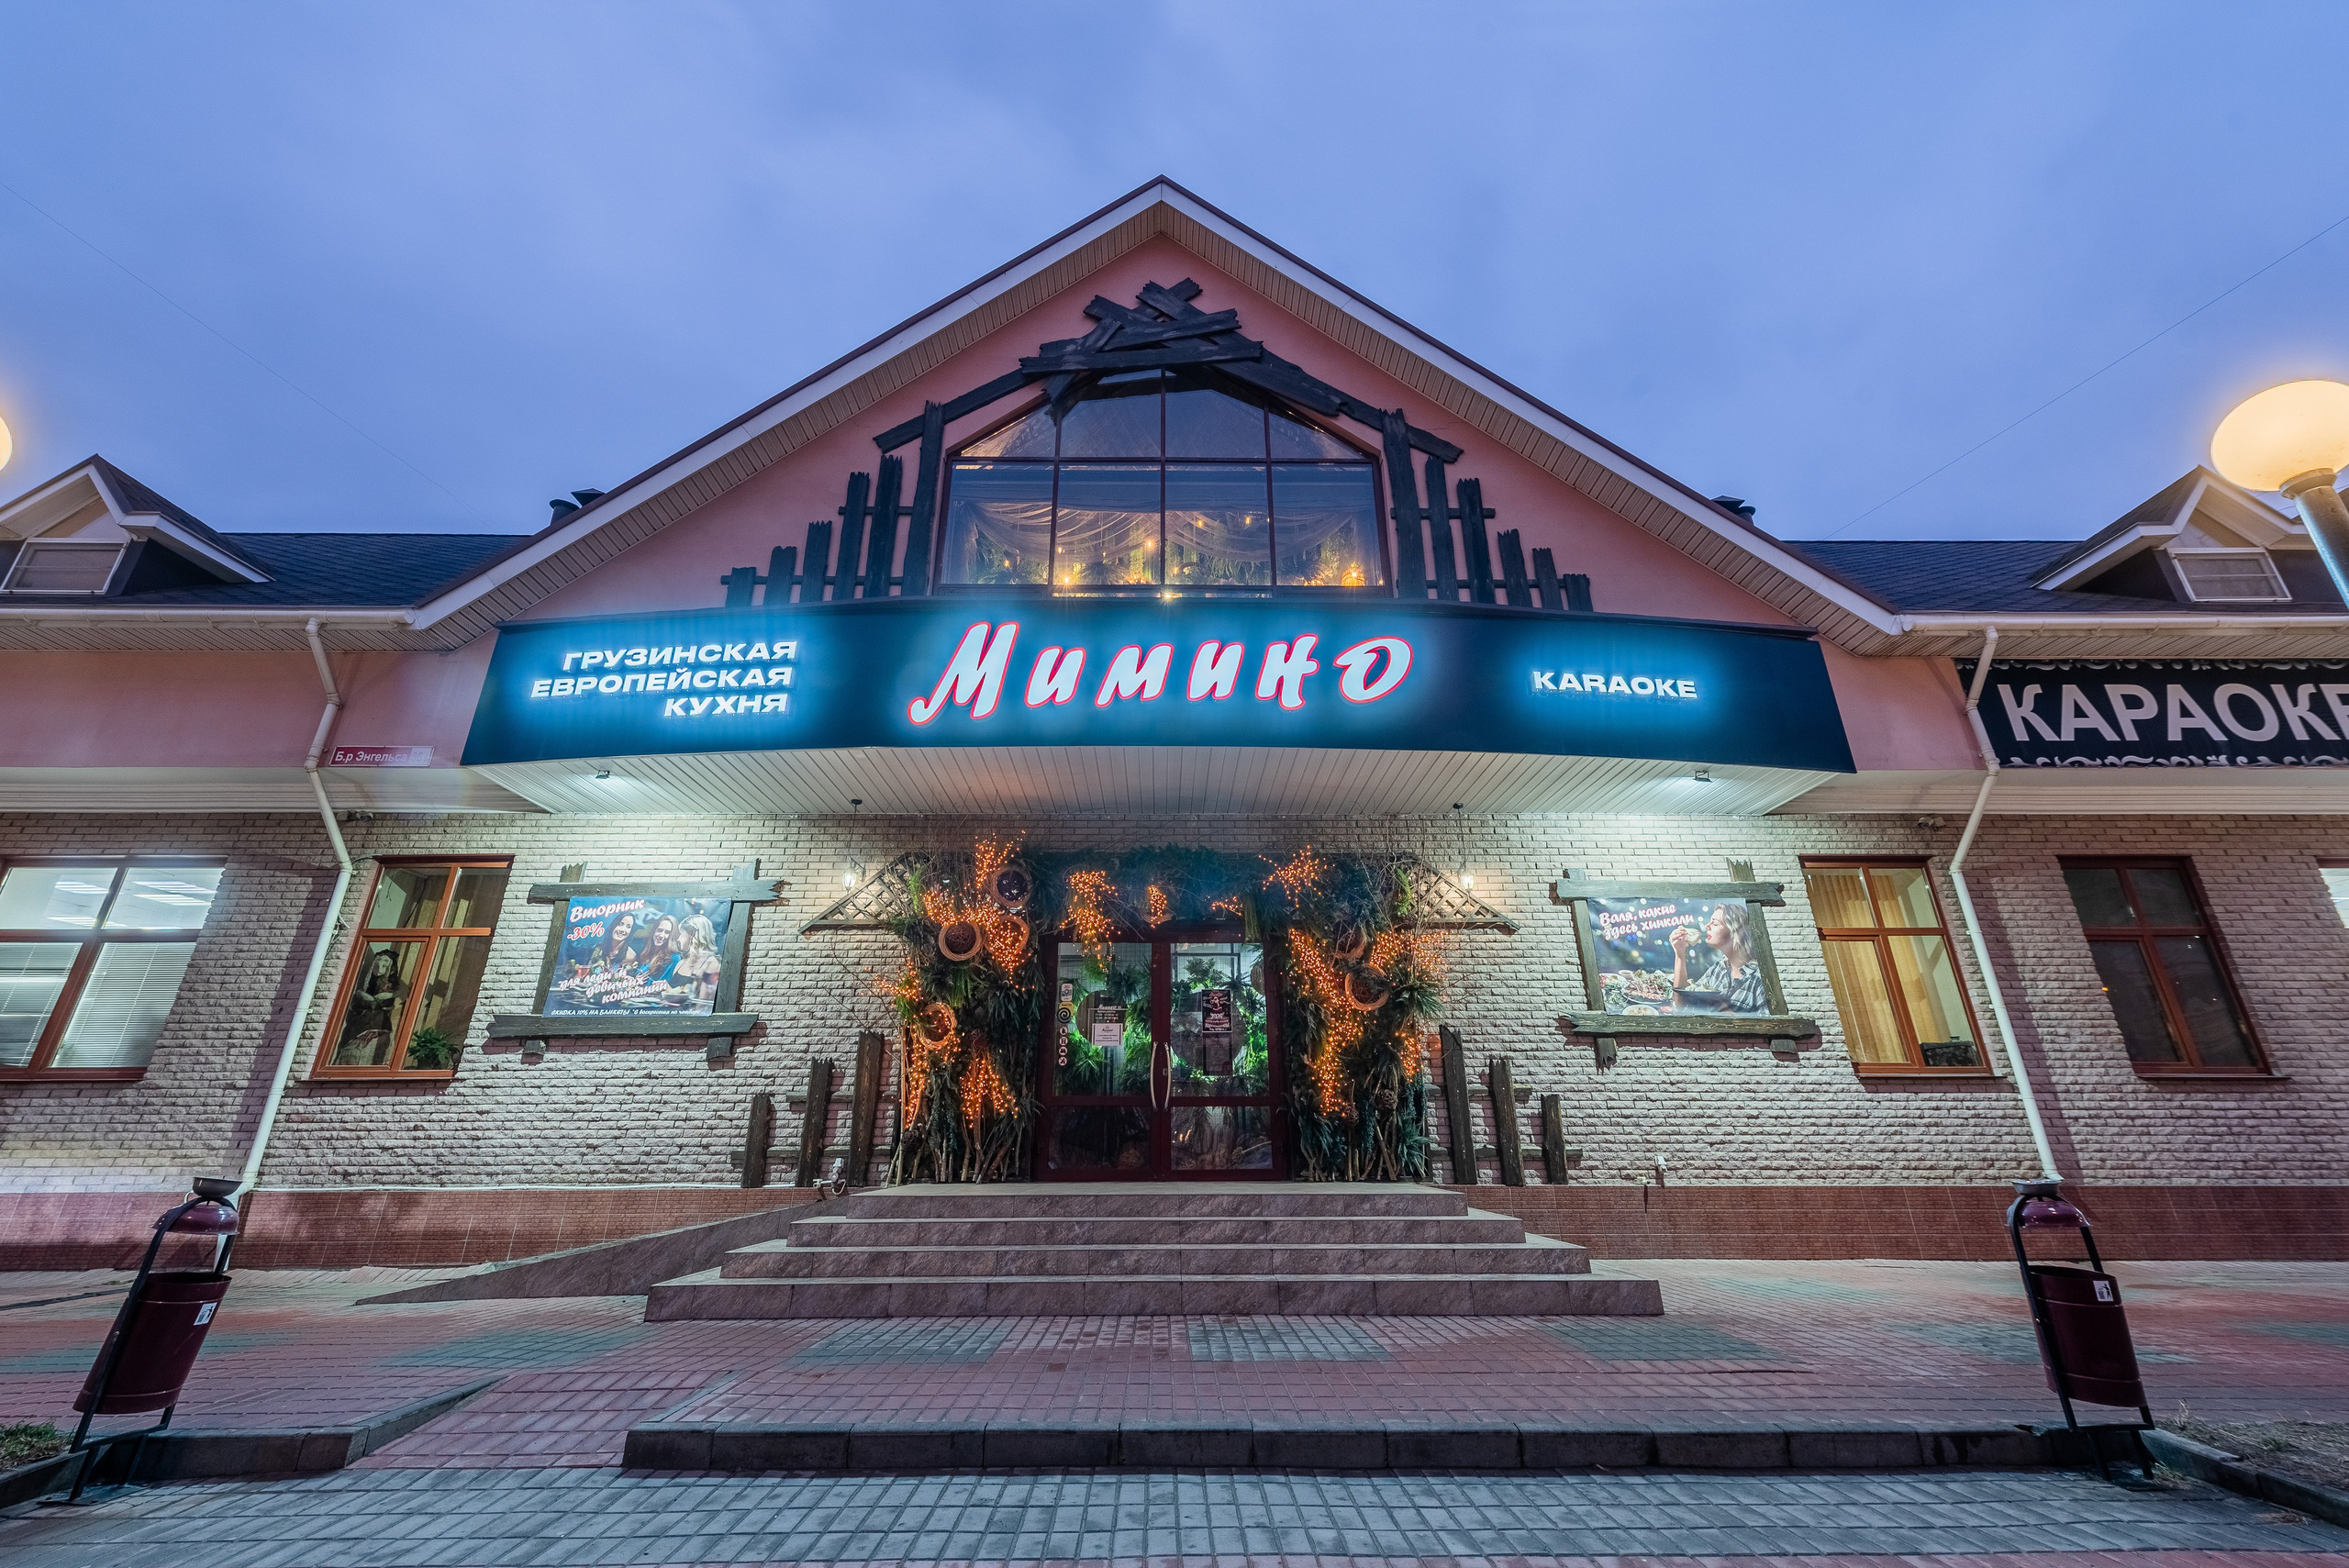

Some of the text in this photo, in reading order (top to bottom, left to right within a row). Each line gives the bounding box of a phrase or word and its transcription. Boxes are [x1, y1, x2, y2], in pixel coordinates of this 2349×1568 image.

[562, 641, 797, 672] ГРУЗИНСКАЯ
[530, 667, 793, 698] ЕВРОПЕЙСКАЯ
[907, 621, 1414, 726] Мимино
[1531, 671, 1698, 699] KARAOKE
[664, 694, 789, 717] КУХНЯ
[355, 751, 407, 762] Энгельса
[569, 899, 645, 923] Вторник
[1598, 904, 1676, 927] Валя, какие
[567, 921, 606, 940] -30%
[1603, 914, 1695, 940] здесь хинкали
[601, 980, 669, 1004] компаний
